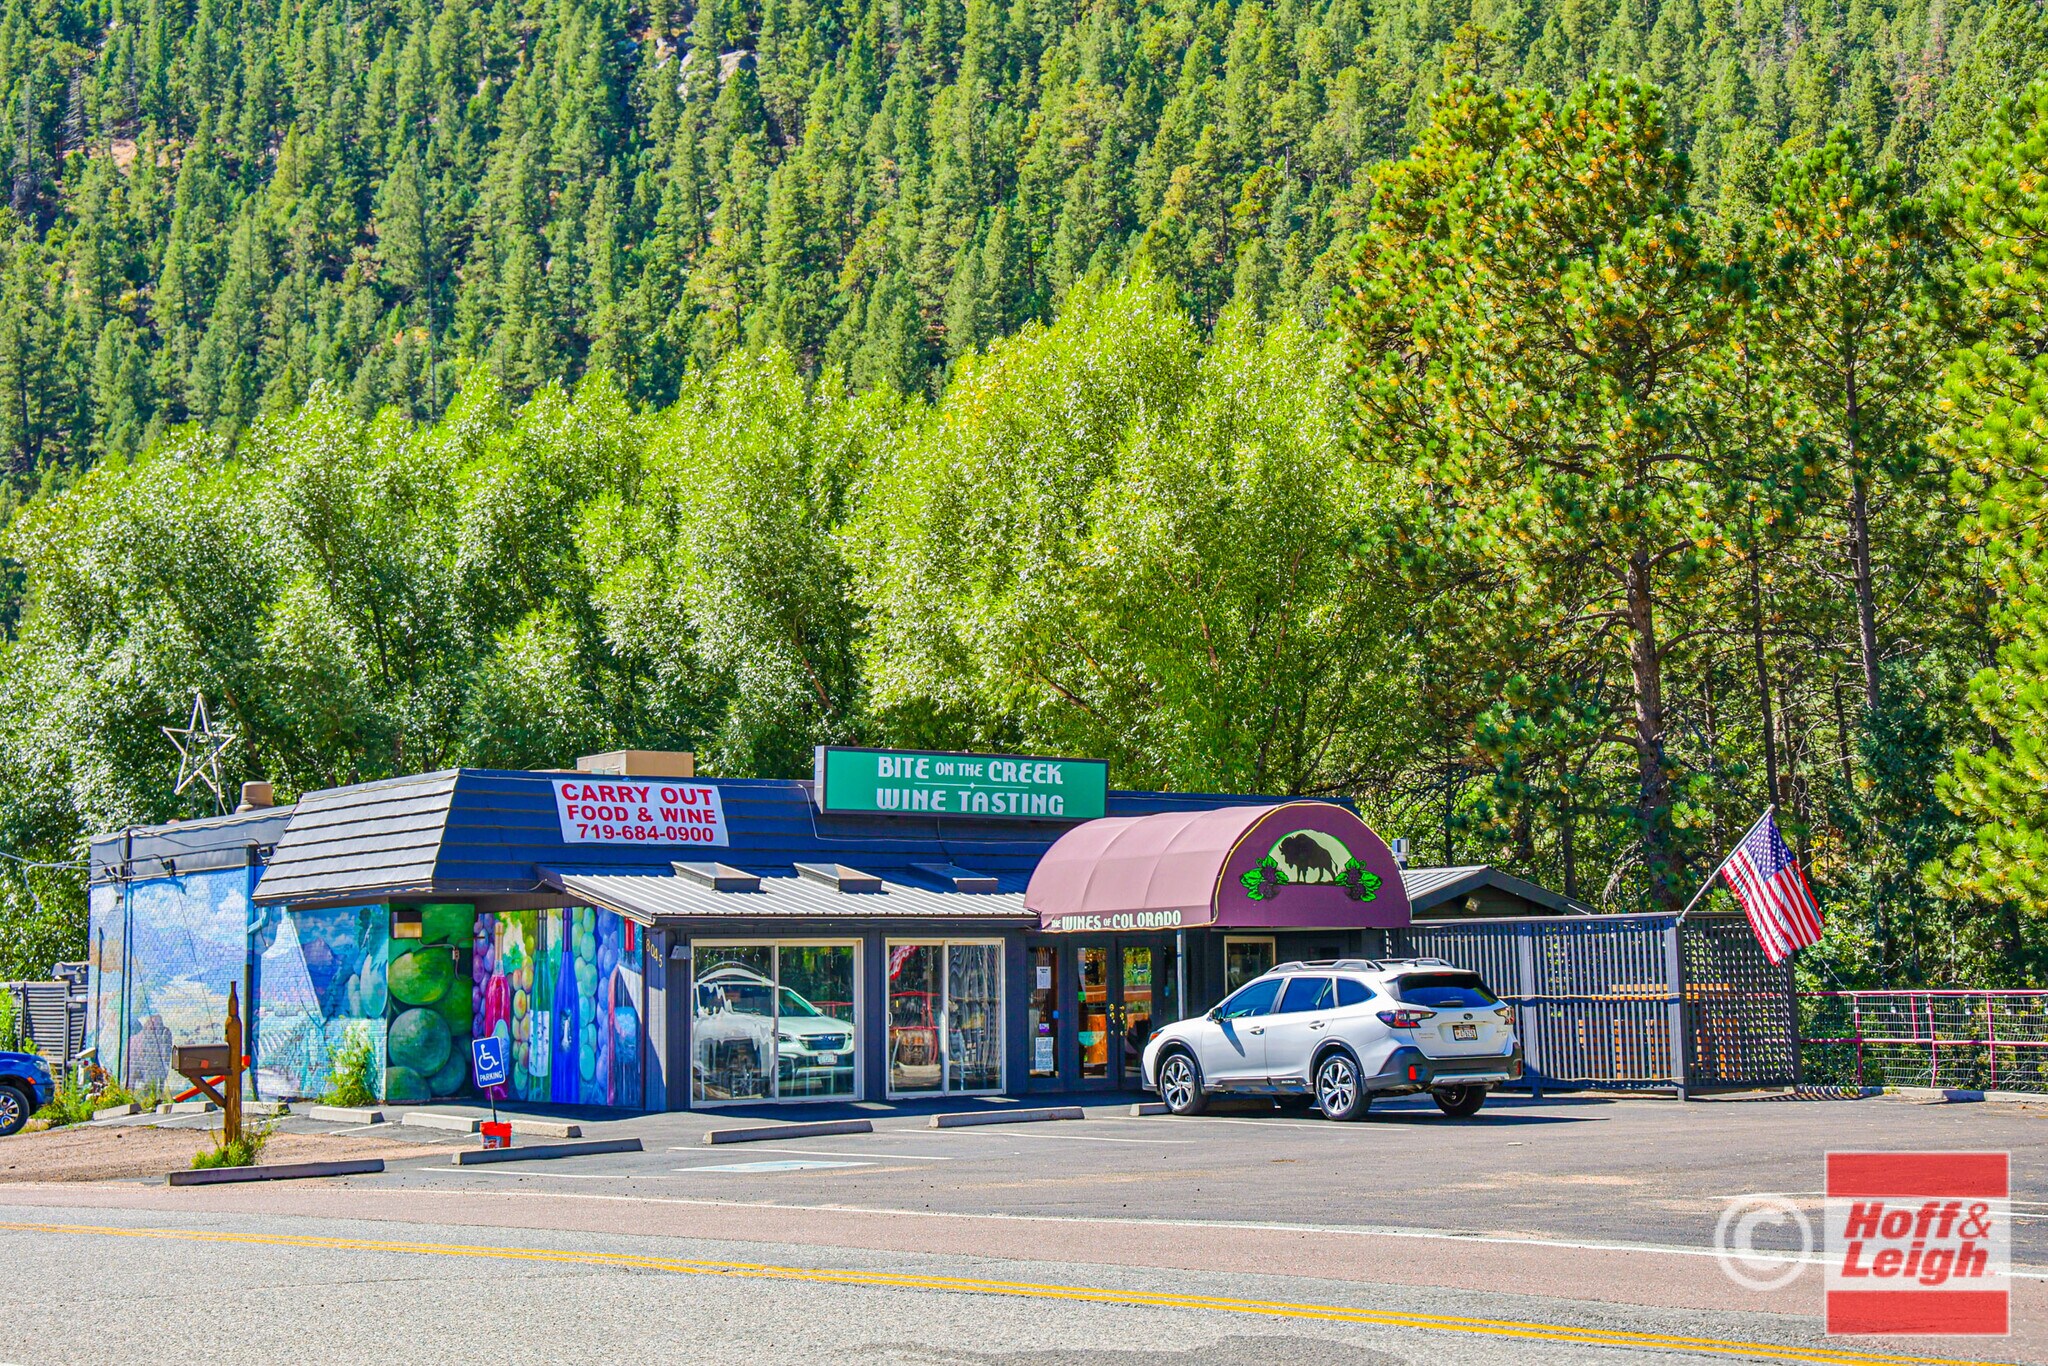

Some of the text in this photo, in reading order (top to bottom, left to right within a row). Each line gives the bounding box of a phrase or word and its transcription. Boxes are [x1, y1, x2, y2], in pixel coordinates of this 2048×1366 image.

[878, 756, 1063, 785] BITE ON THE CREEK
[561, 783, 713, 806] CARRY OUT
[876, 788, 1064, 815] WINE TASTING
[567, 804, 717, 824] FOOD & WINE
[576, 823, 714, 842] 719-684-0900
[1062, 915, 1101, 930] WINES
[1103, 918, 1112, 927] OF
[1112, 909, 1182, 929] COLORADO
[480, 1070, 503, 1083] PARKING
